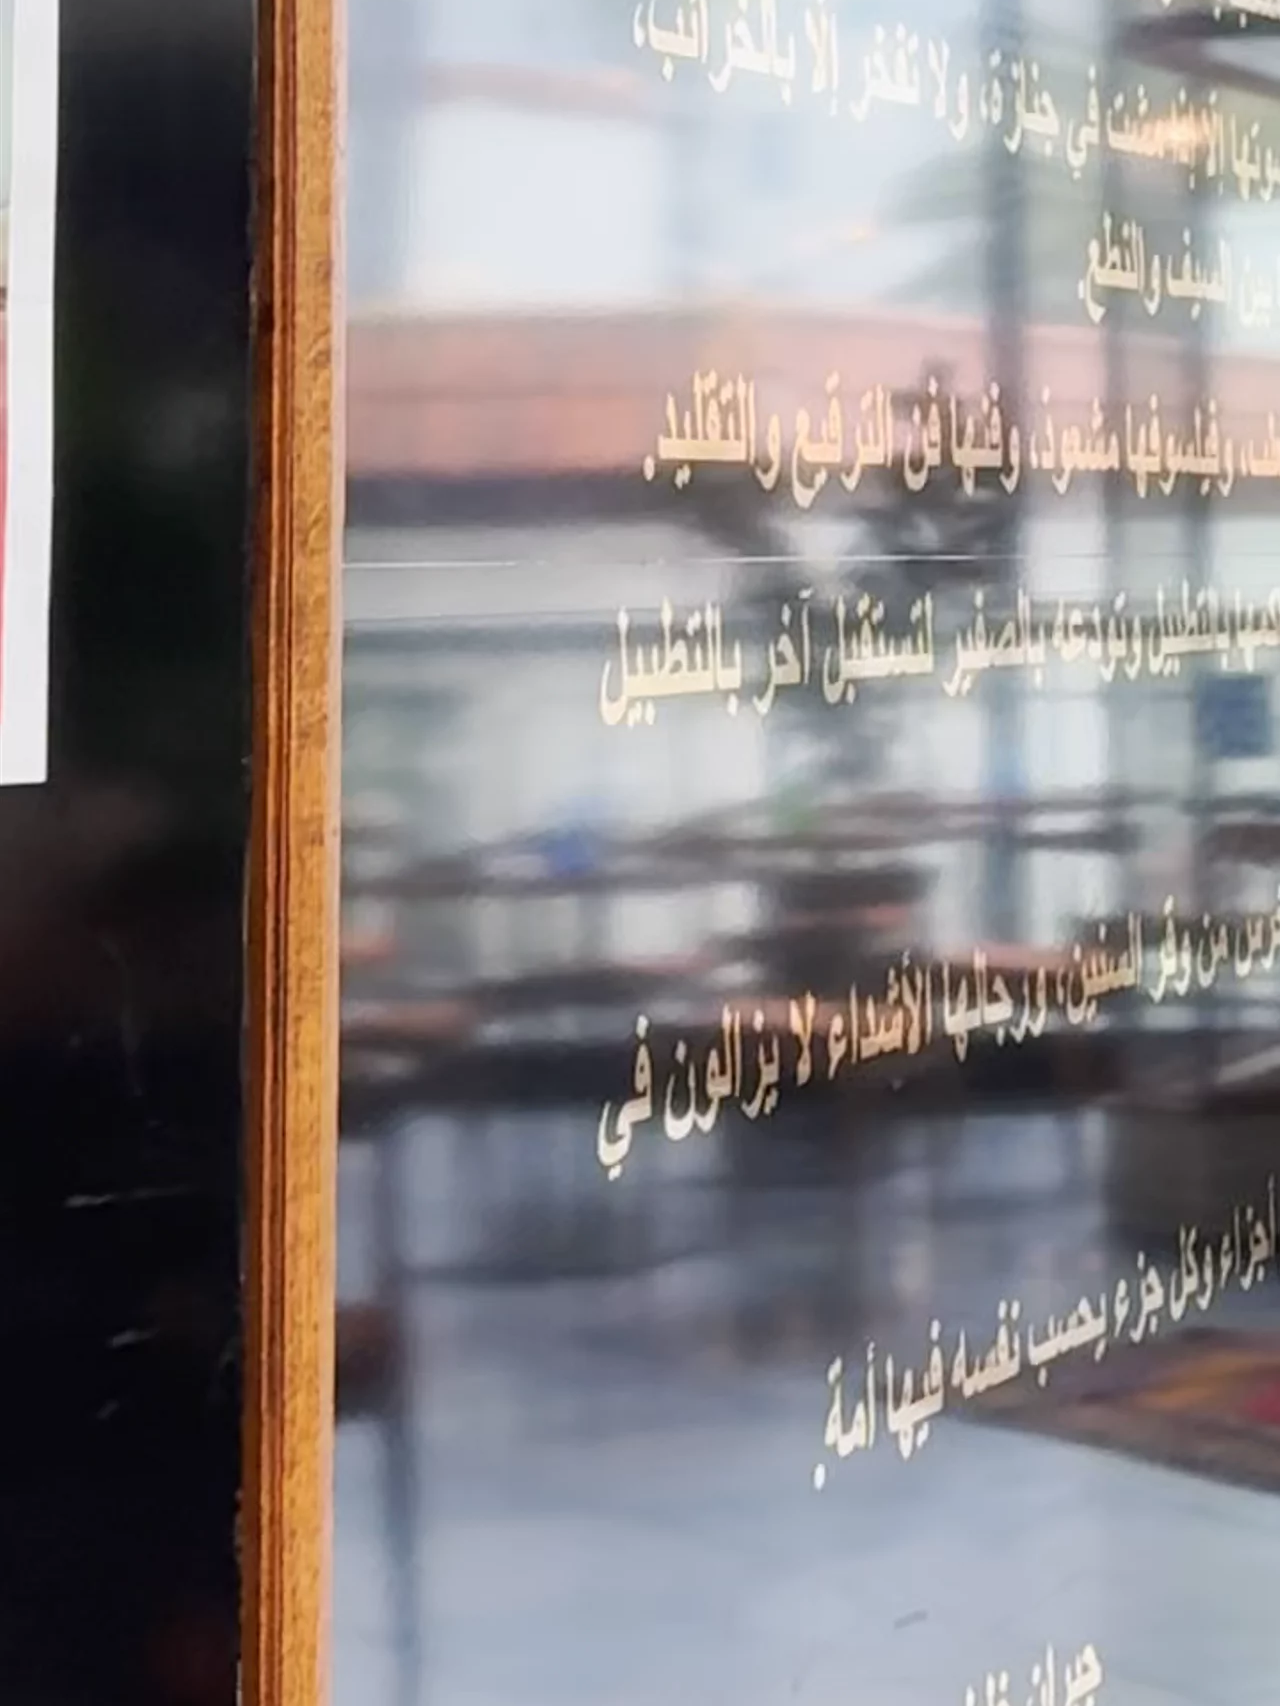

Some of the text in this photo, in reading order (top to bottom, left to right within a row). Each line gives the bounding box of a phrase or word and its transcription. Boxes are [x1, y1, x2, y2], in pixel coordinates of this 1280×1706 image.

[1066, 63, 1100, 180] في
[904, 375, 942, 492] فن
[600, 595, 742, 728] بالتطبيل
[597, 1014, 652, 1181] في
[790, 990, 816, 1087] لا
[885, 1318, 944, 1461] فيها
